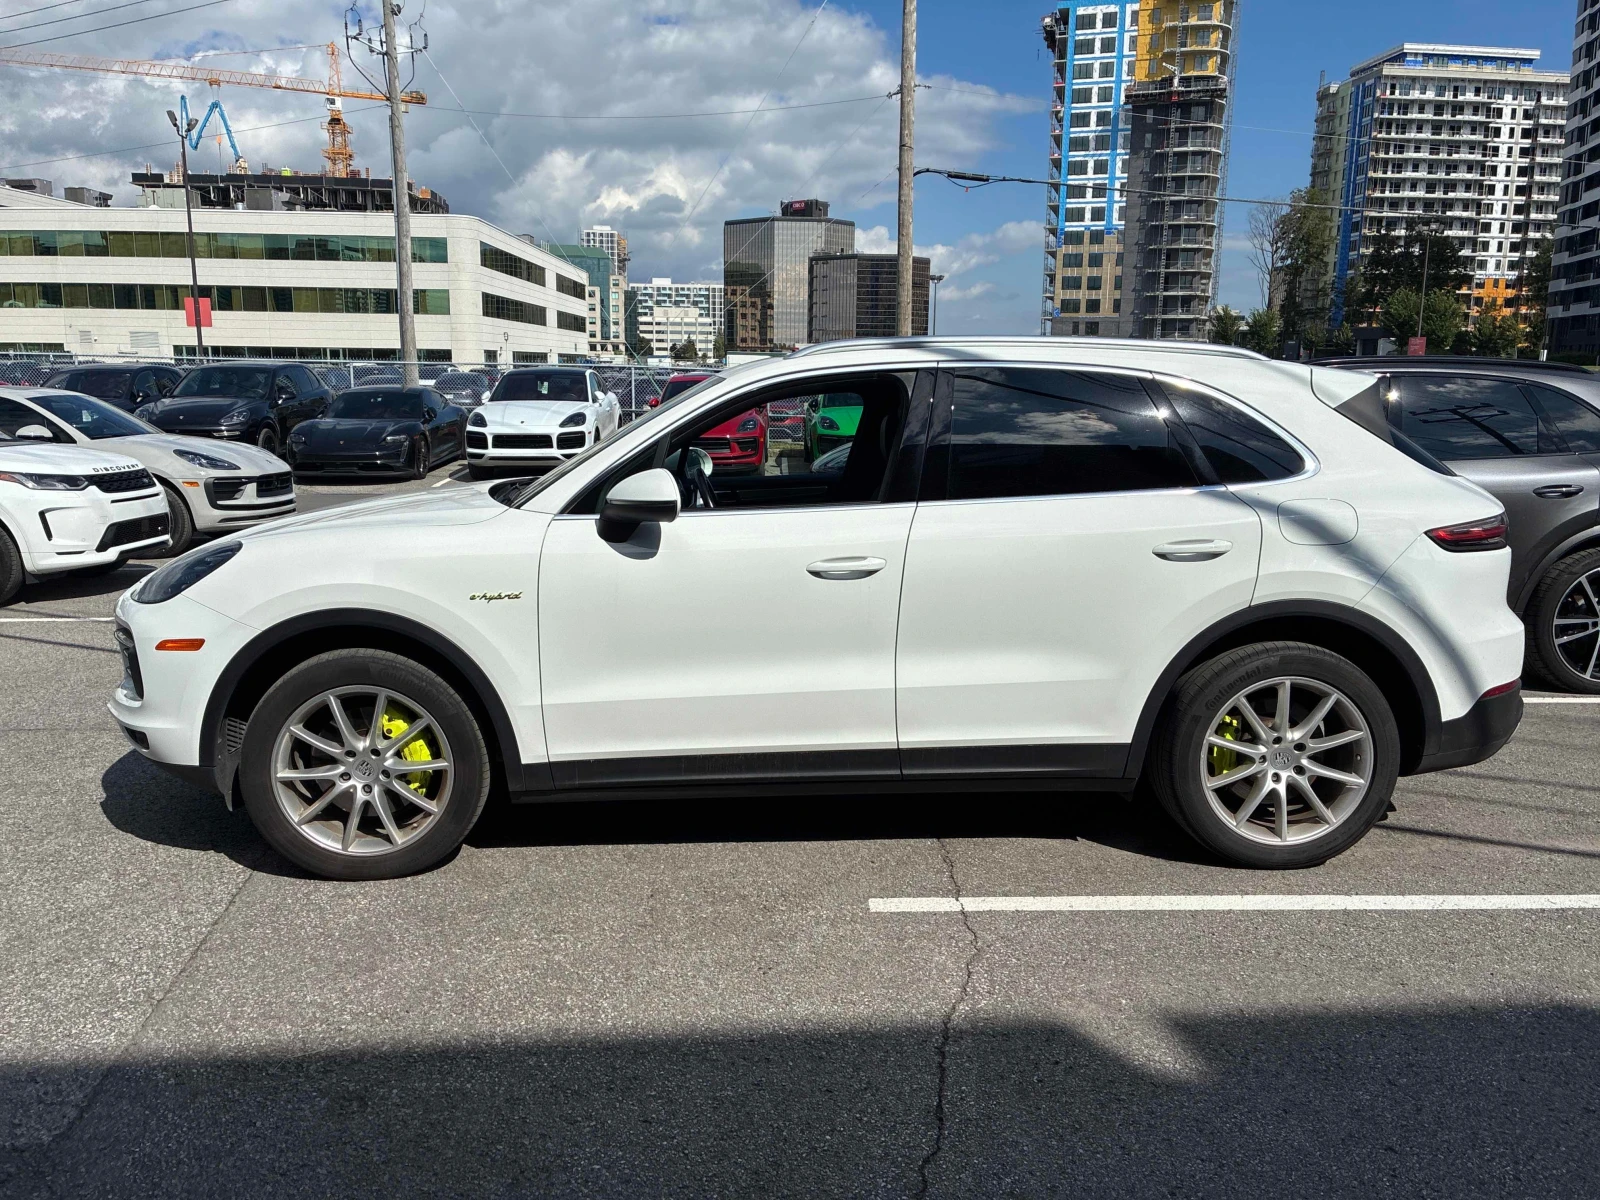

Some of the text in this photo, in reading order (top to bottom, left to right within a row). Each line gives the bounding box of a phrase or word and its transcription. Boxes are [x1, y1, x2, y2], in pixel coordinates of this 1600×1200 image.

[92, 463, 140, 473] DISCOVERY
[469, 591, 523, 604] e-hybrid
[1205, 666, 1262, 711] Continental
